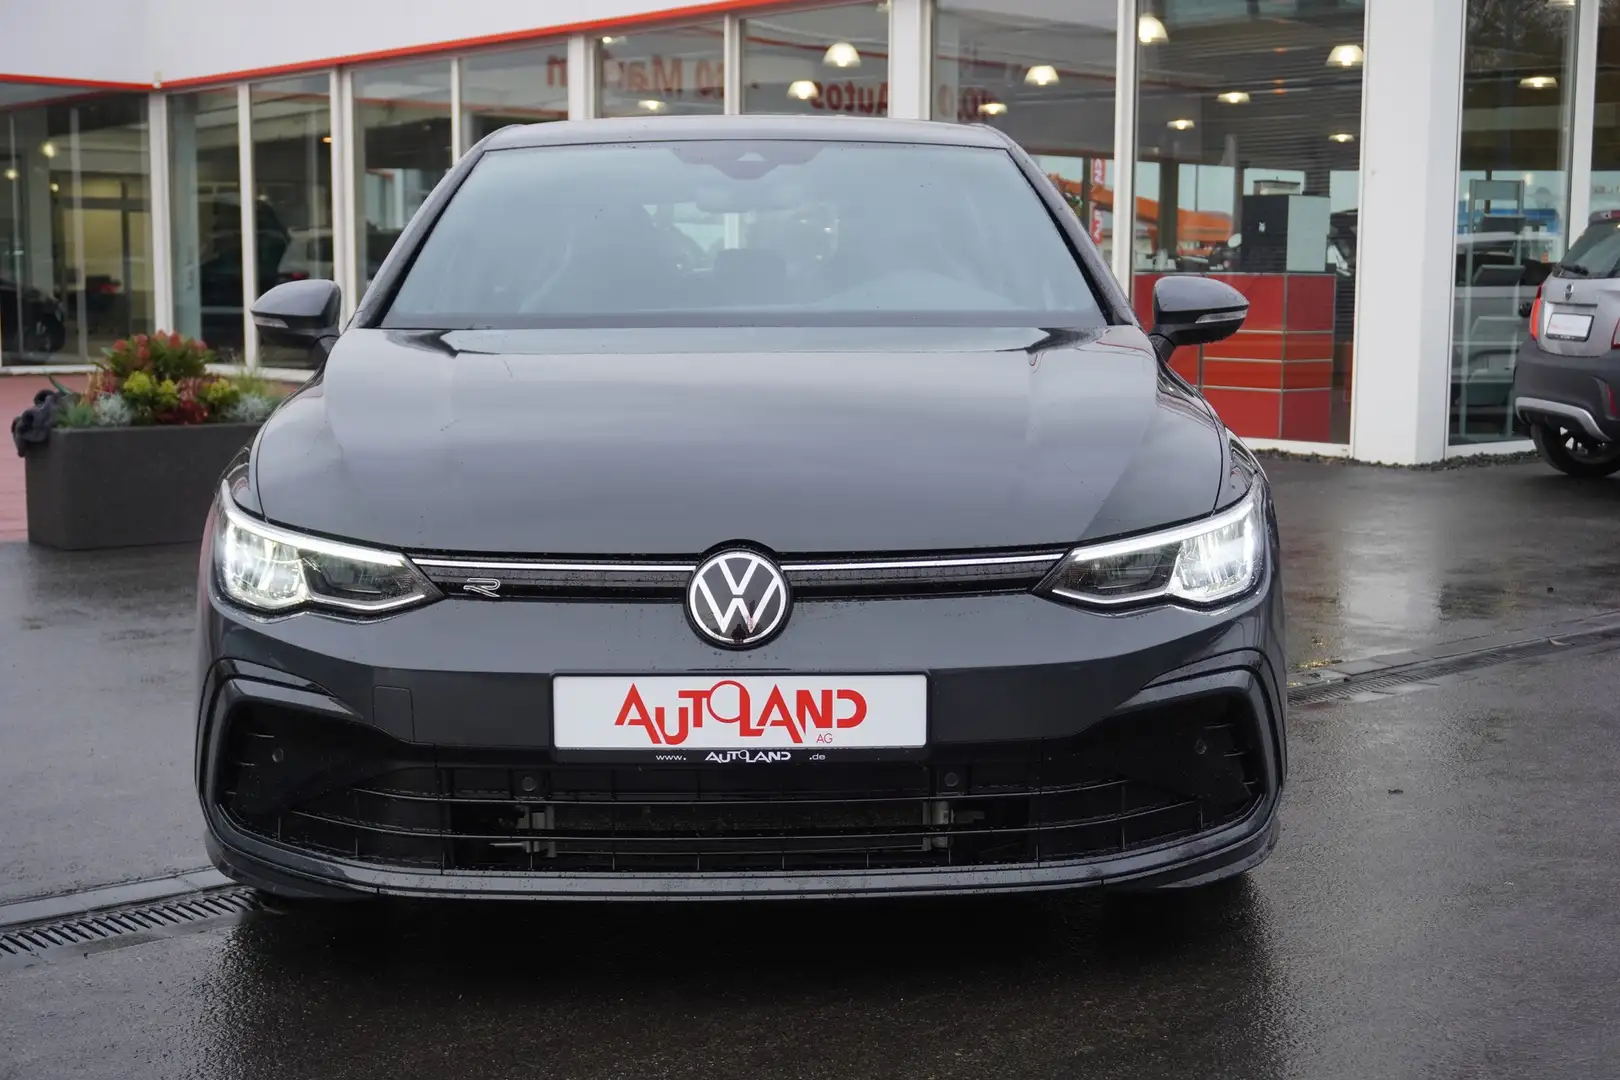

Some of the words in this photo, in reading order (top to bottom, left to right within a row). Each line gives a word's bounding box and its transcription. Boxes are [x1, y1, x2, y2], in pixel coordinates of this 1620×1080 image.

[463, 578, 500, 597] R
[691, 555, 784, 640] VW
[816, 733, 833, 744] AG
[809, 753, 826, 761] .de
